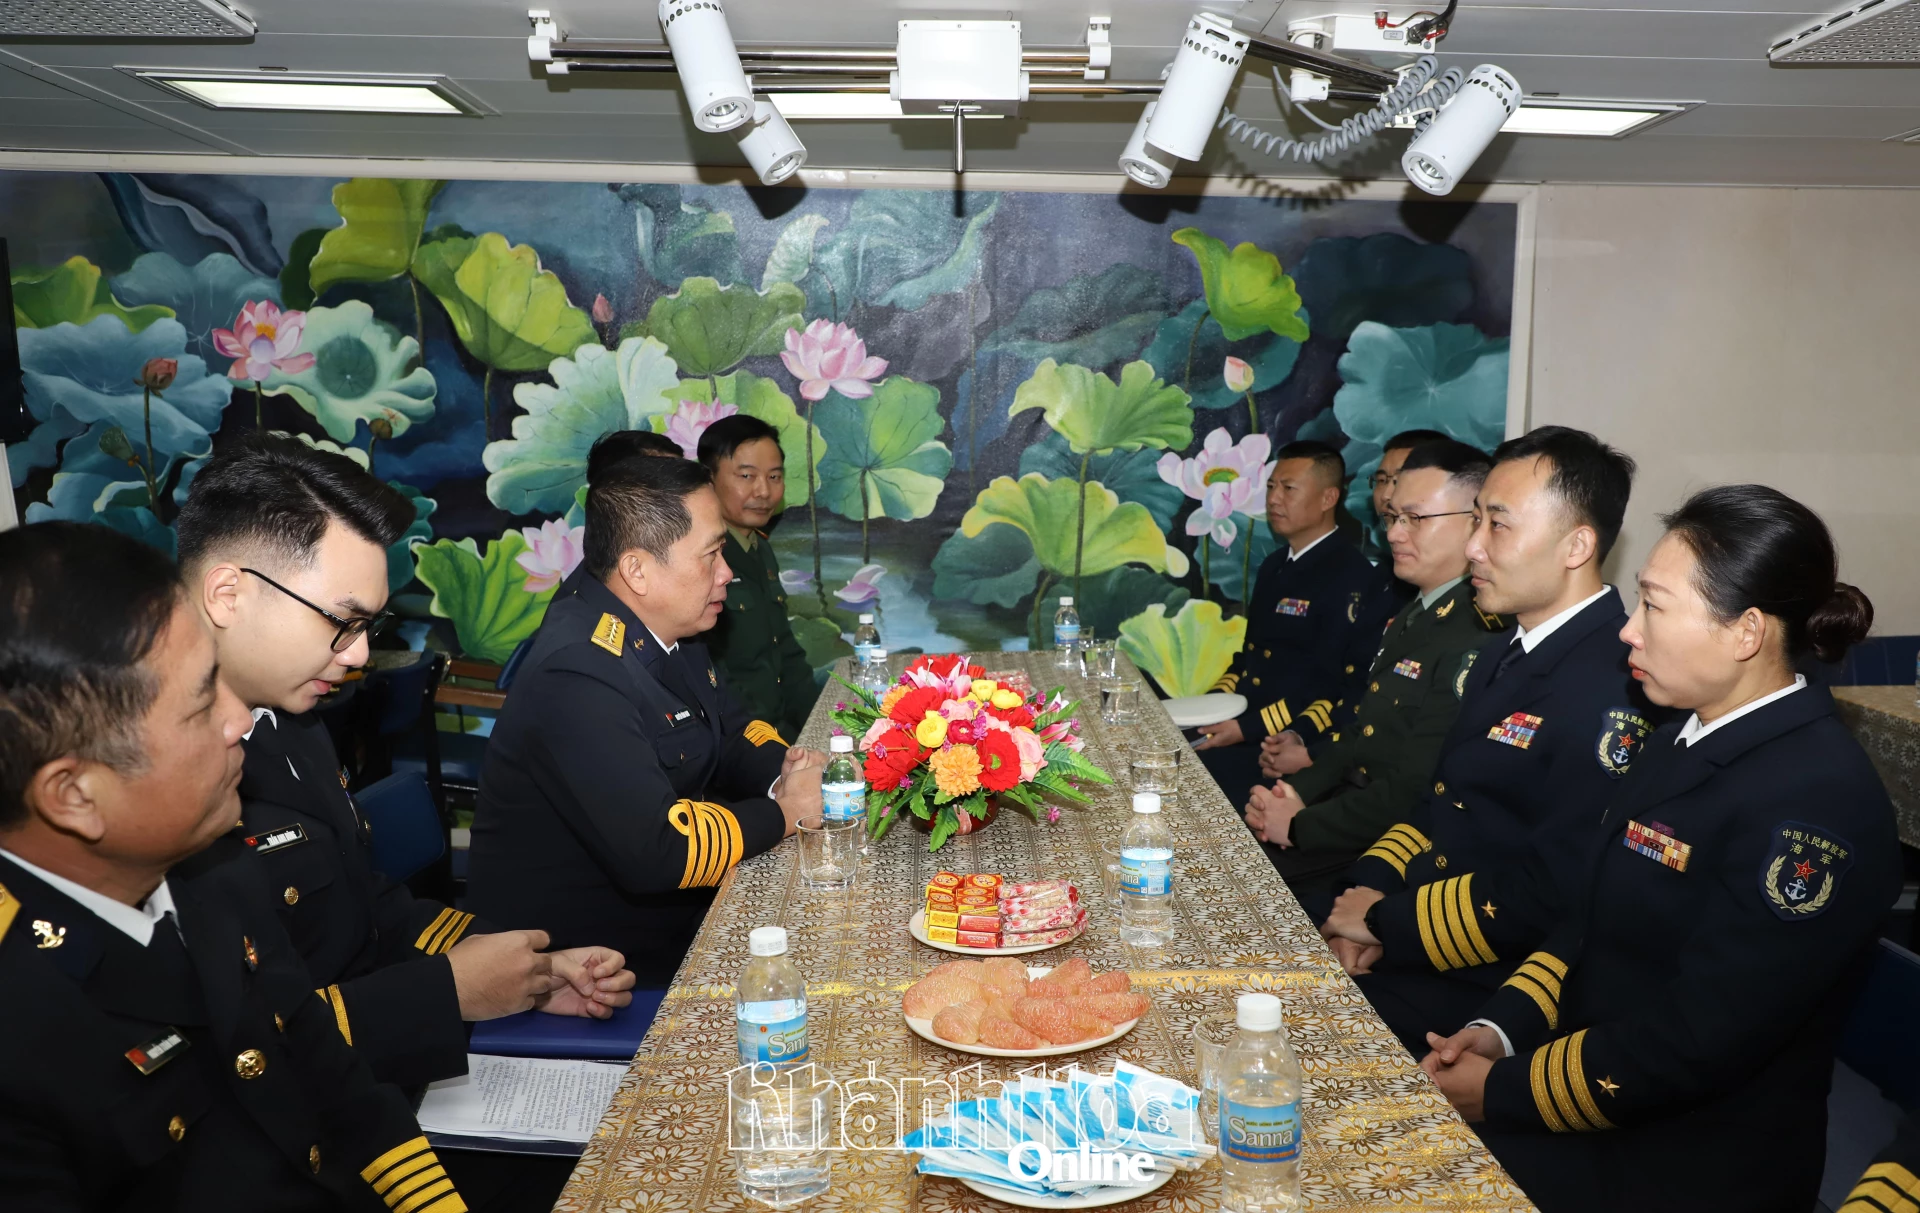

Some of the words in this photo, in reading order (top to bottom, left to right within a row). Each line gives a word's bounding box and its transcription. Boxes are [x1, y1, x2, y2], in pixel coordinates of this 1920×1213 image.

[1782, 828, 1848, 860] 中国人民解放军
[1229, 1116, 1294, 1147] Sanna
